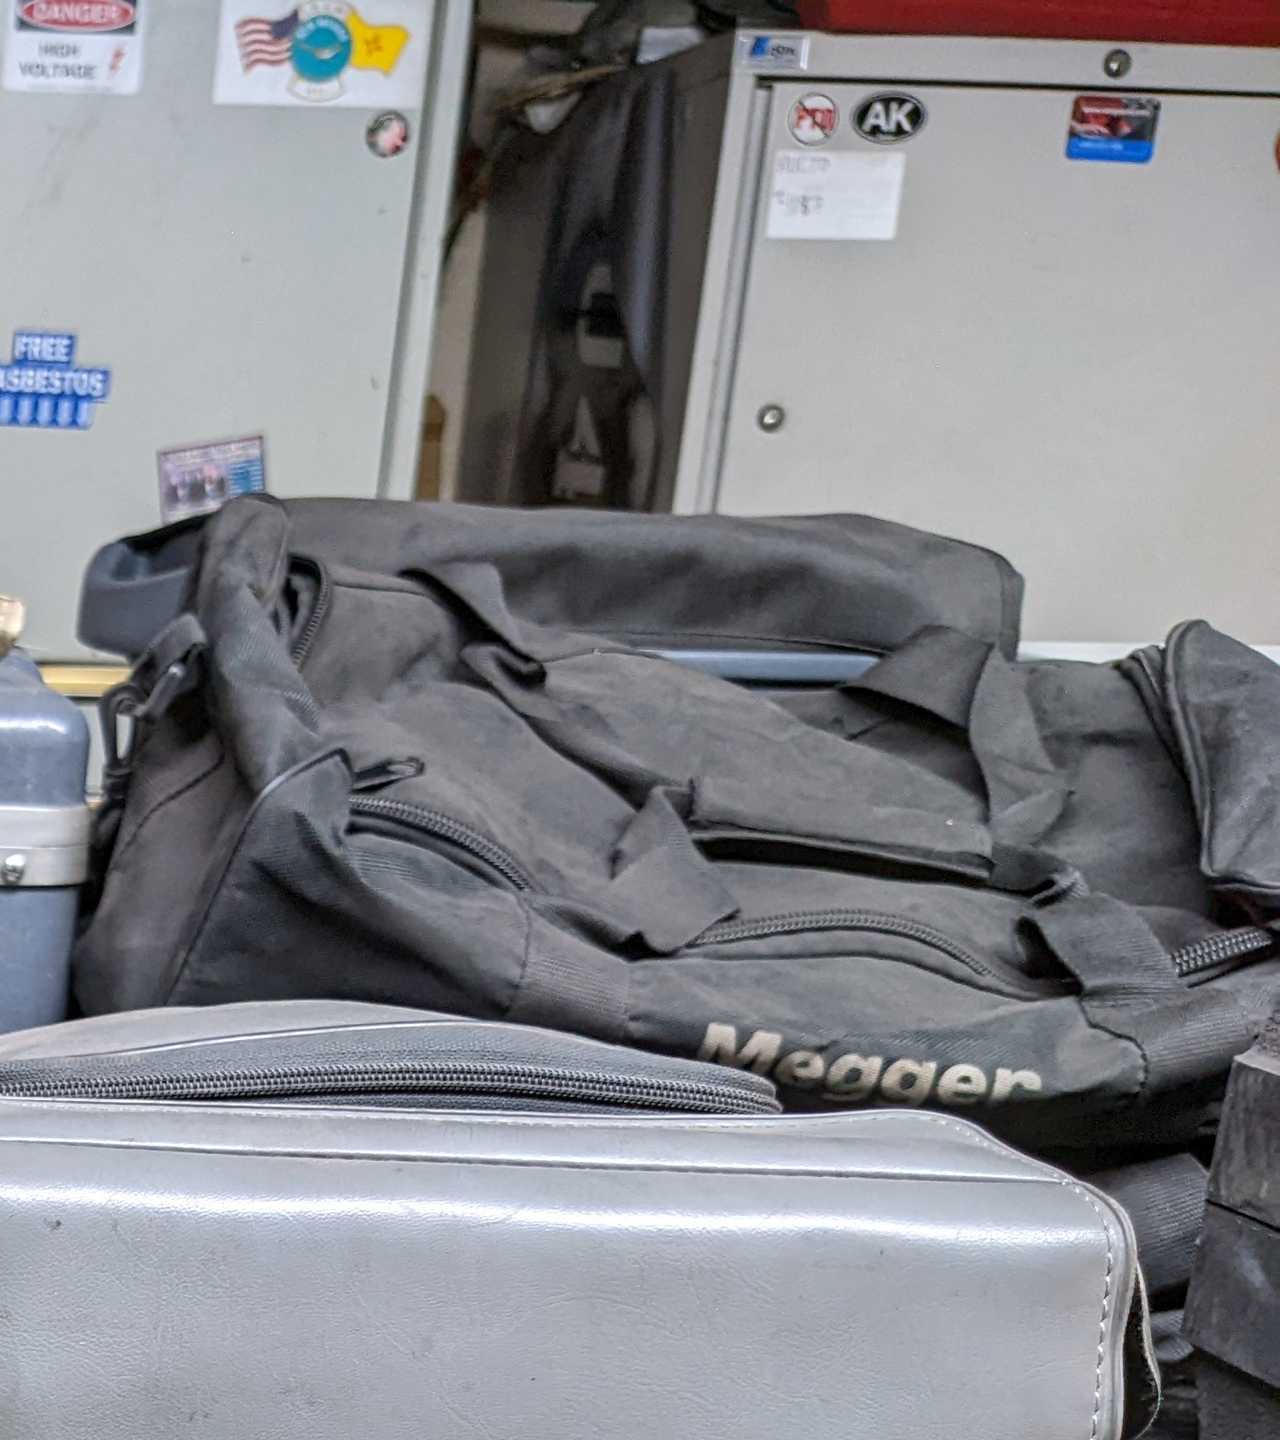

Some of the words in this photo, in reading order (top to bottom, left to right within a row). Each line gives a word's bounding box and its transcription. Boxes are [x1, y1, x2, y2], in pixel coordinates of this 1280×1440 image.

[862, 101, 915, 132] AK
[15, 335, 71, 362] FREE
[698, 1022, 1042, 1105] Megger
